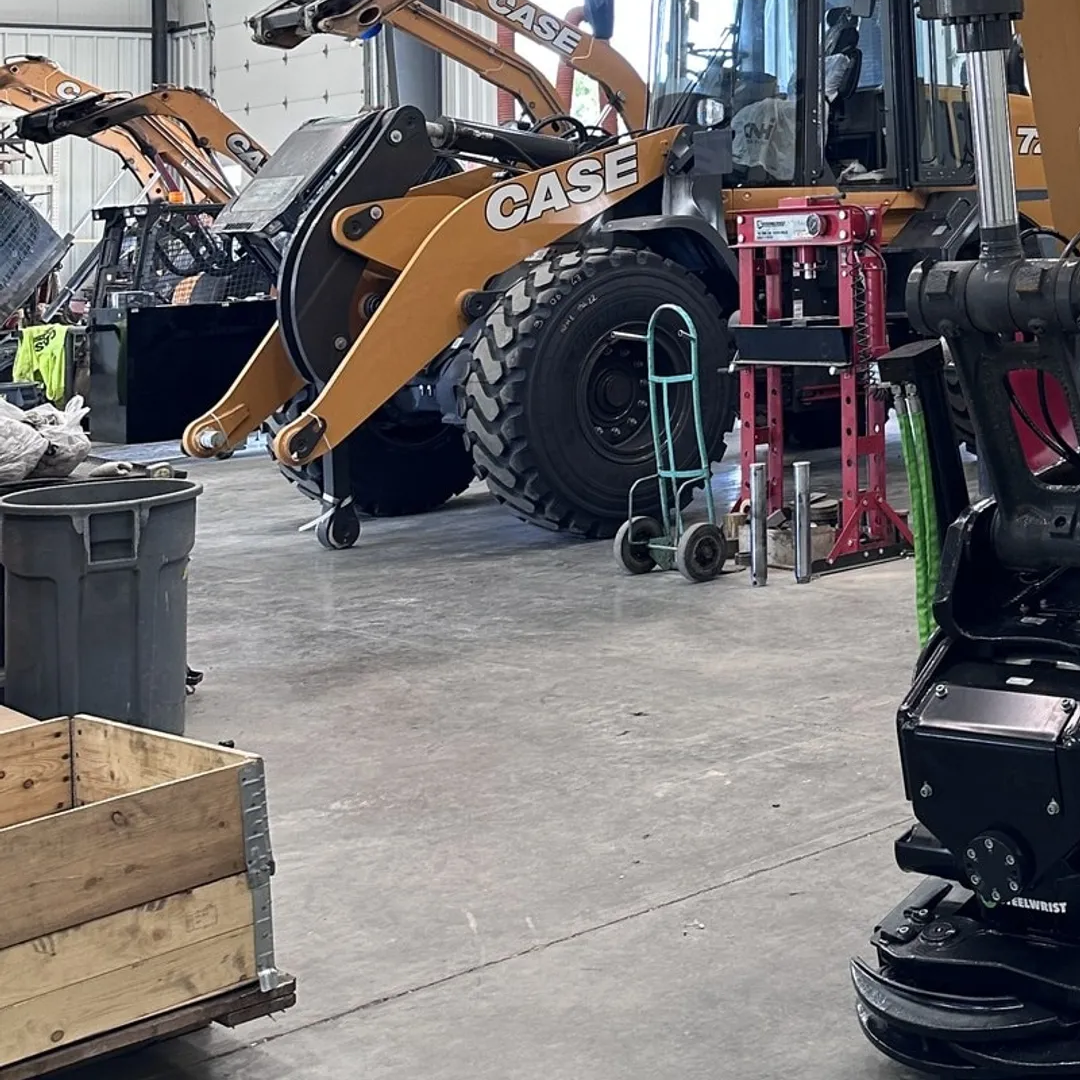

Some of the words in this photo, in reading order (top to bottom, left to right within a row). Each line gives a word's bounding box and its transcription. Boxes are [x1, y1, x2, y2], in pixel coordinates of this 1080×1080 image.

[226, 132, 268, 174] CA
[485, 142, 639, 231] CASE
[1001, 897, 1067, 913] EELWRIST
